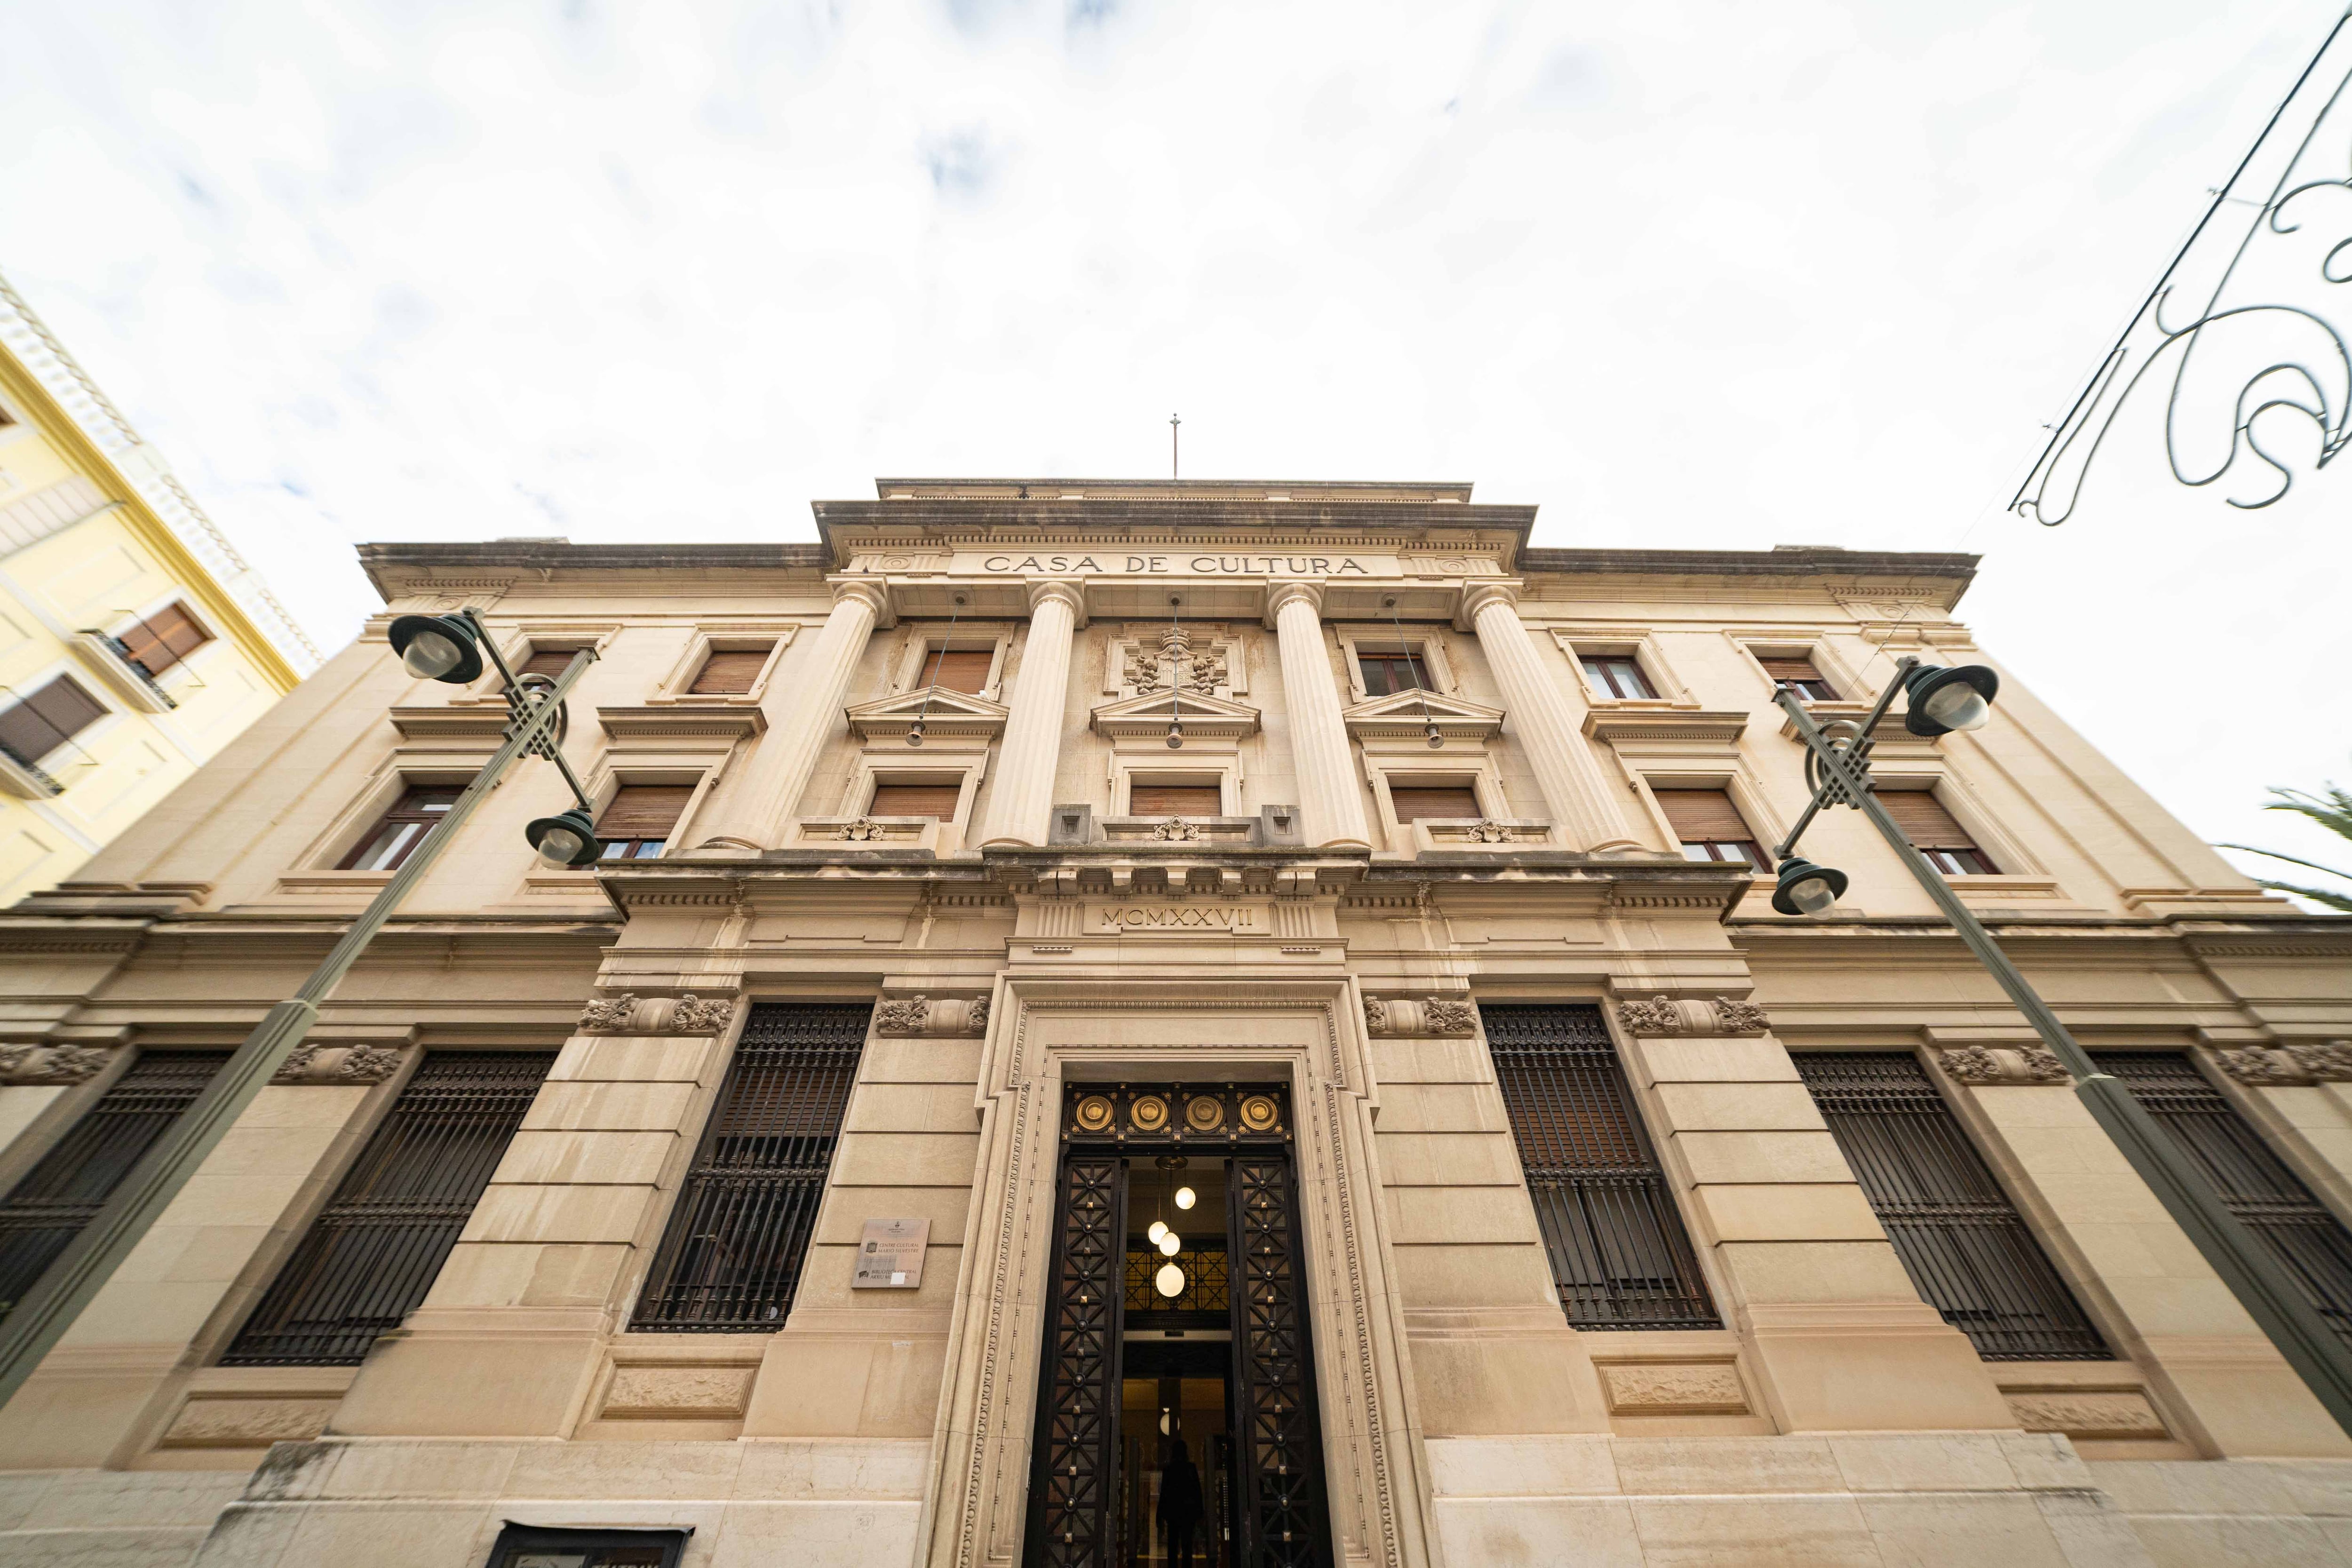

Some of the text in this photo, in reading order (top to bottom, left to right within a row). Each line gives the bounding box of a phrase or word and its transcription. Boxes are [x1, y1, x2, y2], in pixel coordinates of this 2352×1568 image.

[984, 556, 1369, 573] CASA DE CULTURA
[1102, 908, 1252, 925] MCMXXVII
